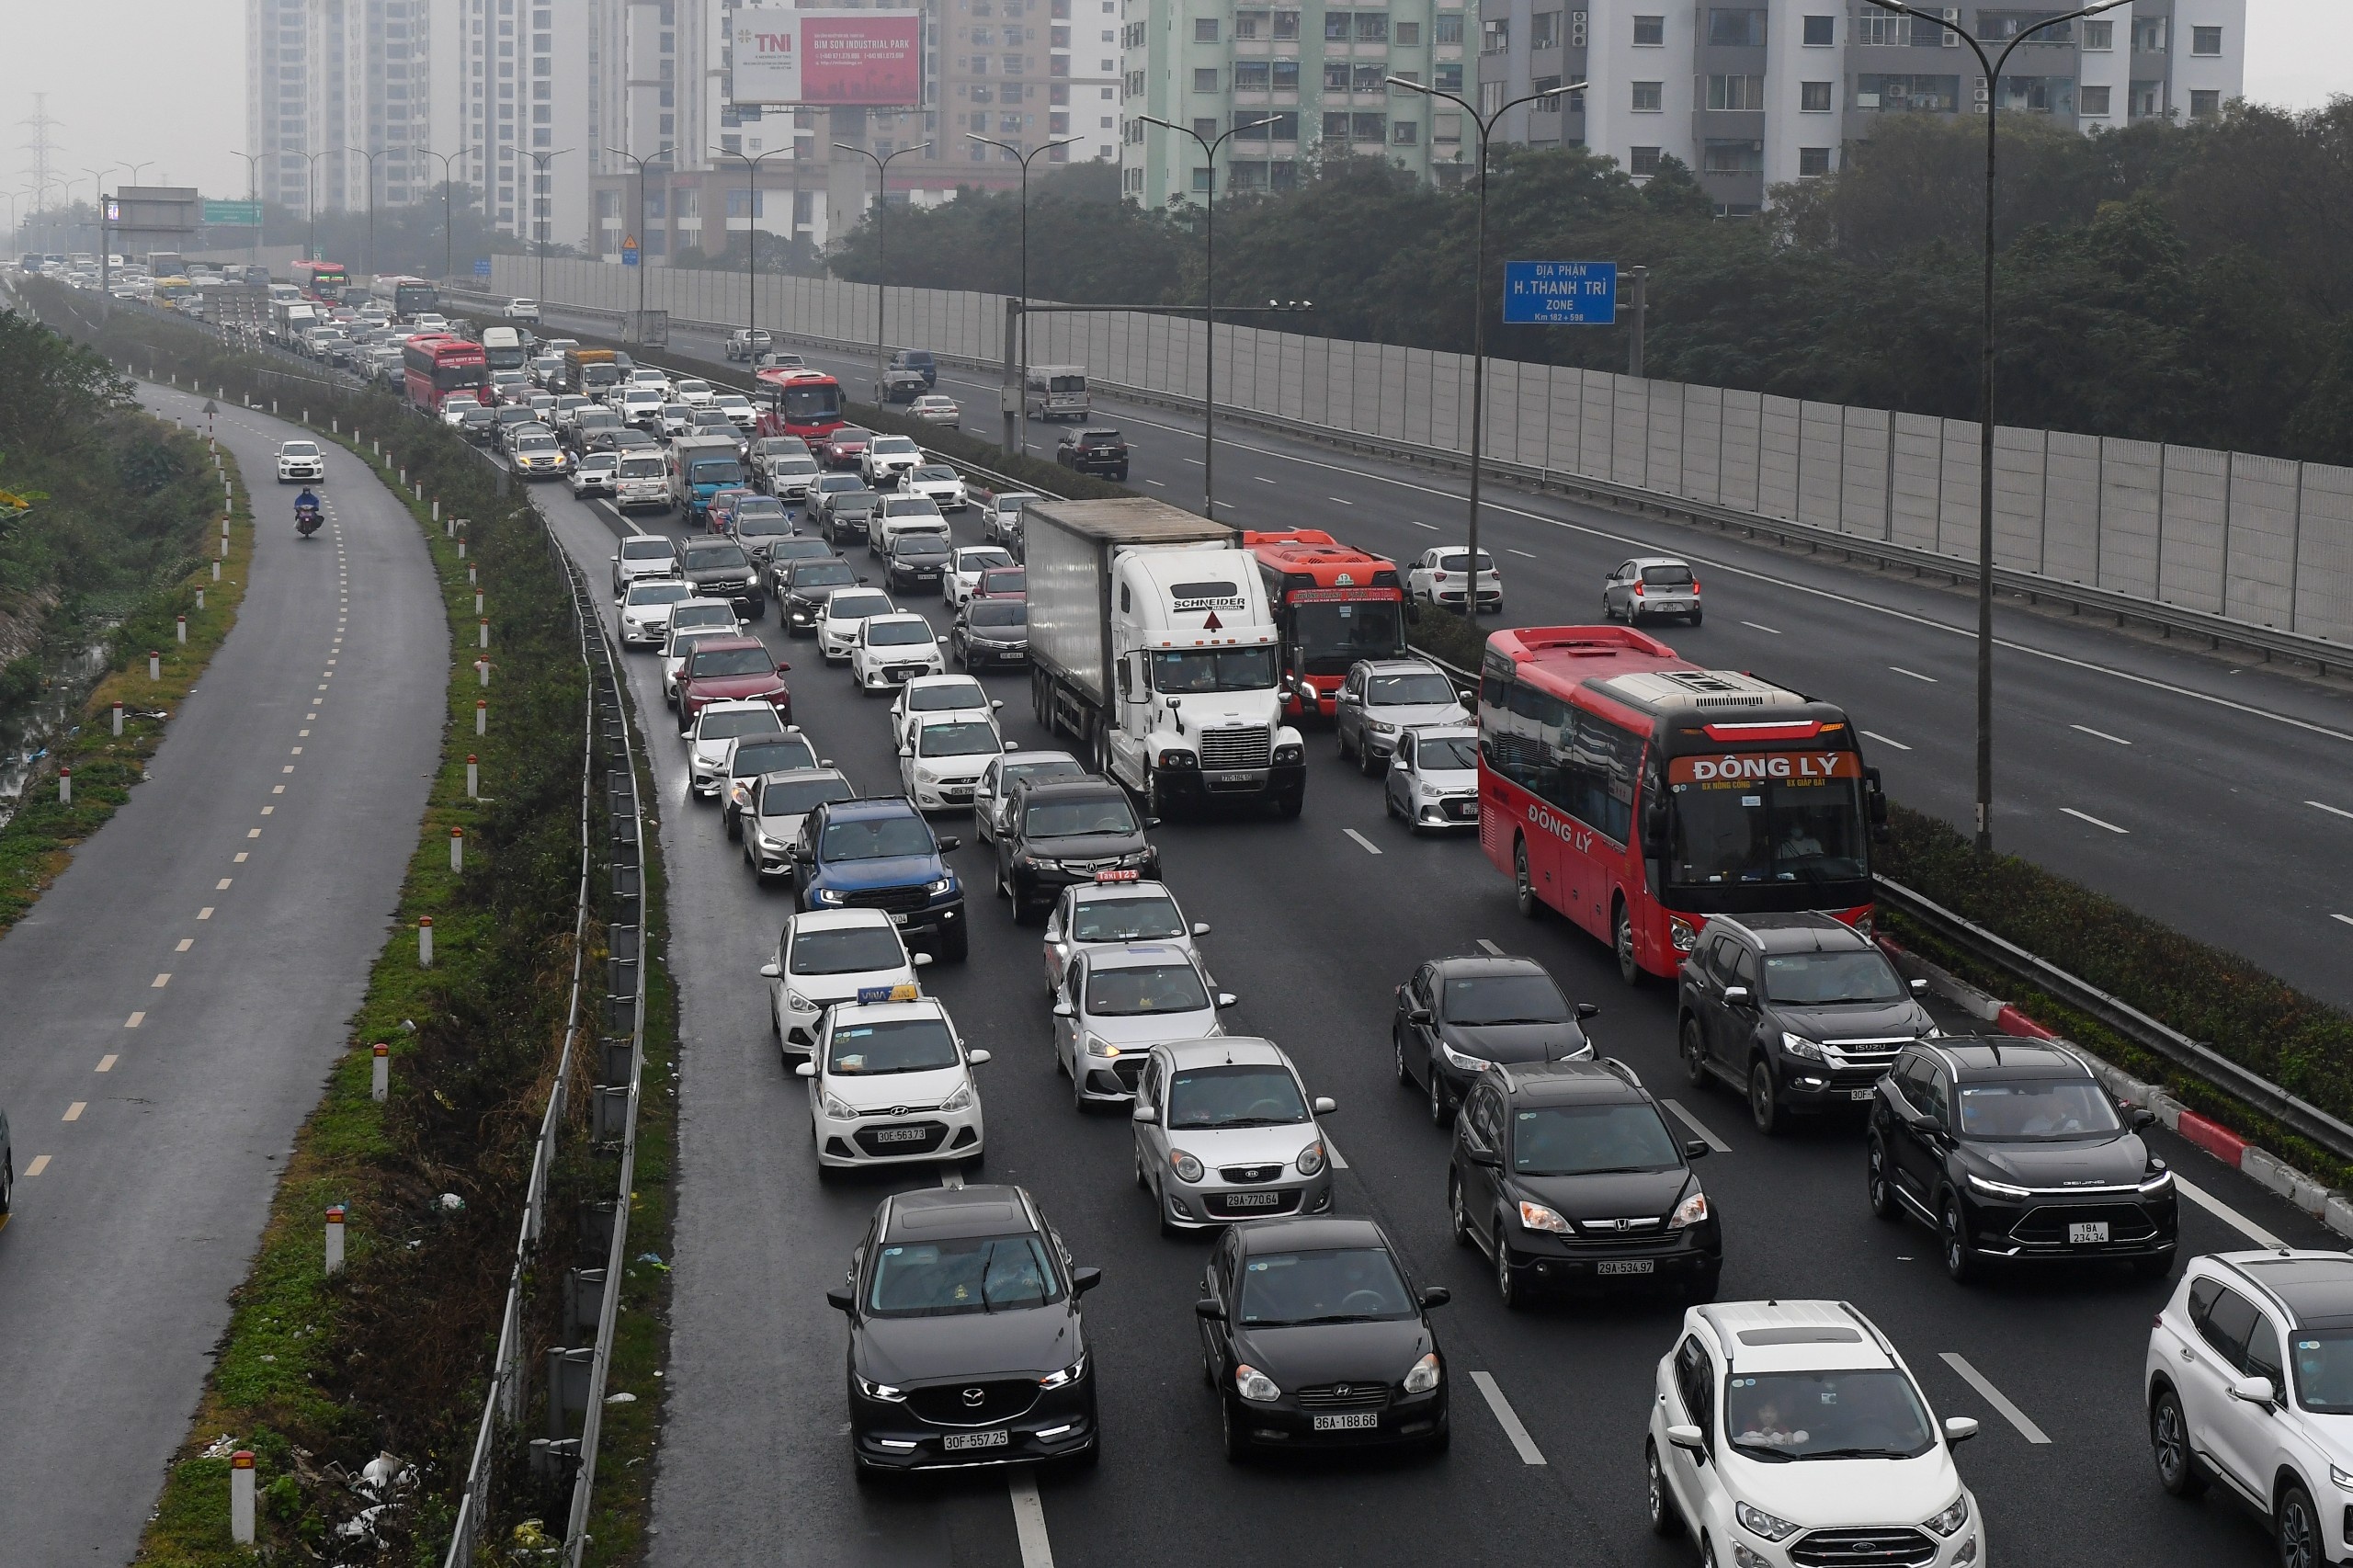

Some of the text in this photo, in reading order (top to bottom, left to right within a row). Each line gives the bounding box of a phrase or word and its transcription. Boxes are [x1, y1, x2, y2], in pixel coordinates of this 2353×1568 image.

[755, 34, 791, 51] TNI
[814, 40, 827, 49] BIM
[846, 40, 888, 49] INDUSTRIAL
[891, 40, 909, 49] PARK
[1536, 263, 1586, 278] ĐỊA PHẬN
[1585, 278, 1607, 295] TRÌ
[1546, 300, 1574, 311] ZONE
[1174, 598, 1245, 608] SCHNEIDER
[1693, 753, 1839, 779] ĐÔNG LÝ
[1575, 831, 1593, 854] LÝ
[1098, 869, 1137, 880] Taxi 123
[1228, 1195, 1277, 1206] 29A-770.64
[2081, 1223, 2097, 1233] 18A
[2074, 1233, 2105, 1243] 234.34
[1599, 1262, 1653, 1274] 29A-534.97
[1315, 1415, 1376, 1428] 36A-188.66
[946, 1432, 1006, 1449] 30F-557.25
